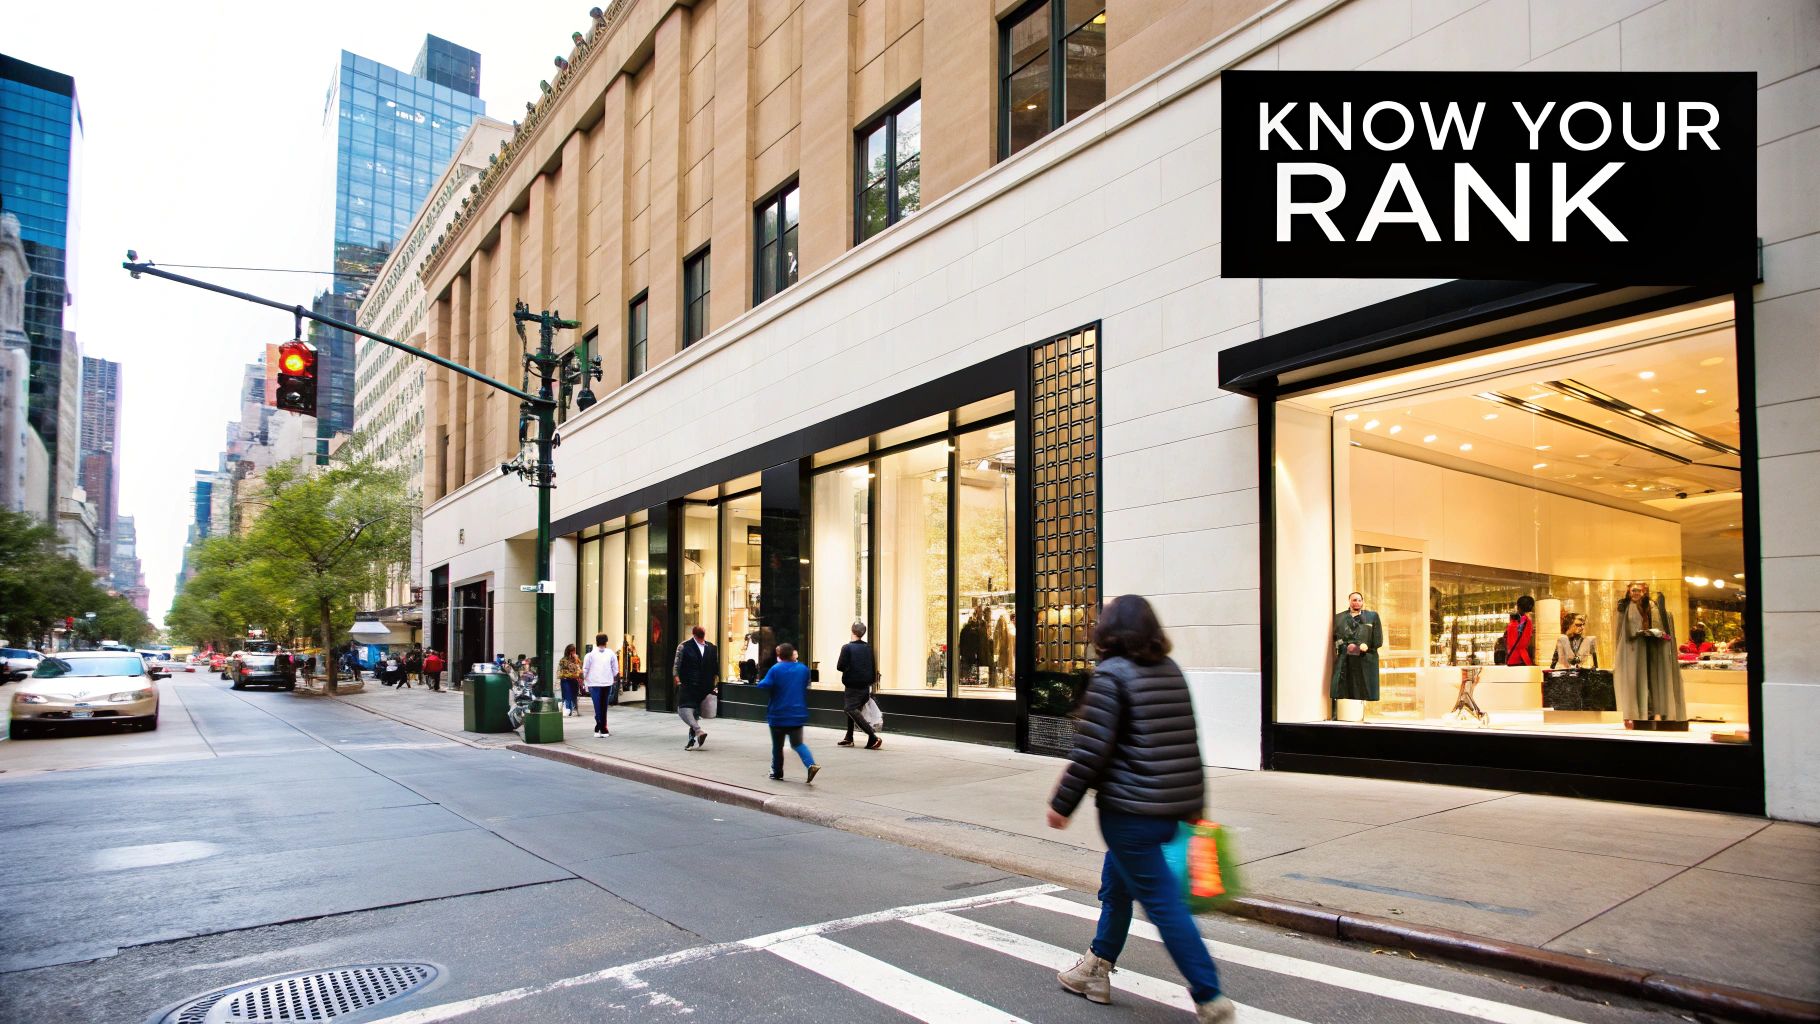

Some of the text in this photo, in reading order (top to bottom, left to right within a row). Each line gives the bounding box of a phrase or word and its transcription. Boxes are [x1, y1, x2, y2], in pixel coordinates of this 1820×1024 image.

[1259, 101, 1721, 151] KNOW YOUR
[1276, 162, 1629, 242] RANK
